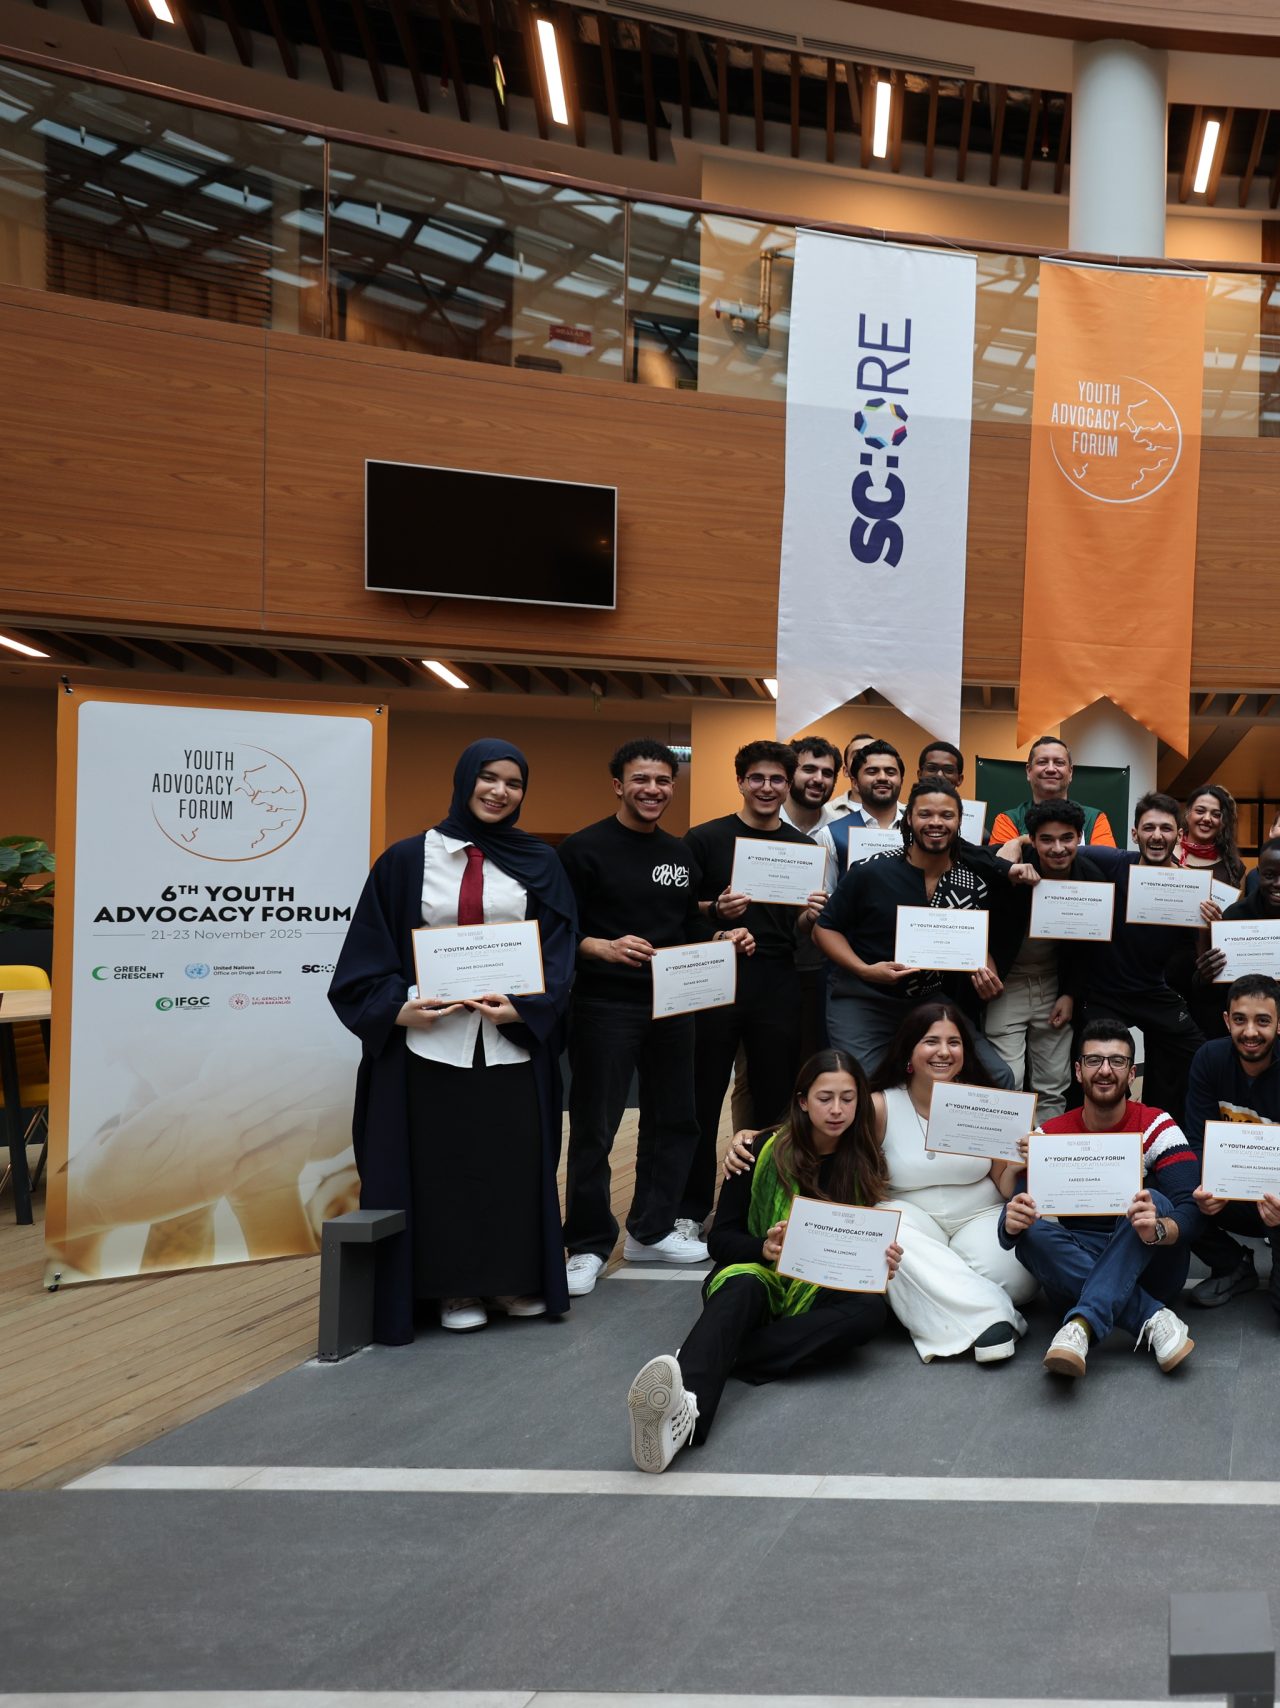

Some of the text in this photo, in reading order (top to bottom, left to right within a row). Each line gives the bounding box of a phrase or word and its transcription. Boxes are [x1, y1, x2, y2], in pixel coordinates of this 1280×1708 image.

[1077, 379, 1121, 405] YOUTH
[1051, 403, 1120, 431] ADVOCACY
[1071, 431, 1119, 457] FORUM
[184, 749, 235, 771] YOUTH
[151, 773, 235, 795] ADVOCACY
[179, 798, 233, 820] FORUM
[160, 885, 295, 902] 6TH YOUTH
[92, 906, 352, 923] ADVOCACY FORUM
[151, 929, 302, 940] 21-23 November 2025
[465, 943, 499, 951] ADVOCACY
[113, 965, 147, 973] GREEN
[113, 972, 165, 980] CRESCENT
[175, 996, 210, 1006] IFGC
[970, 1106, 999, 1114] ADVOCACY
[814, 1223, 833, 1232] YOUTH
[834, 1227, 865, 1236] ADVOCACY
